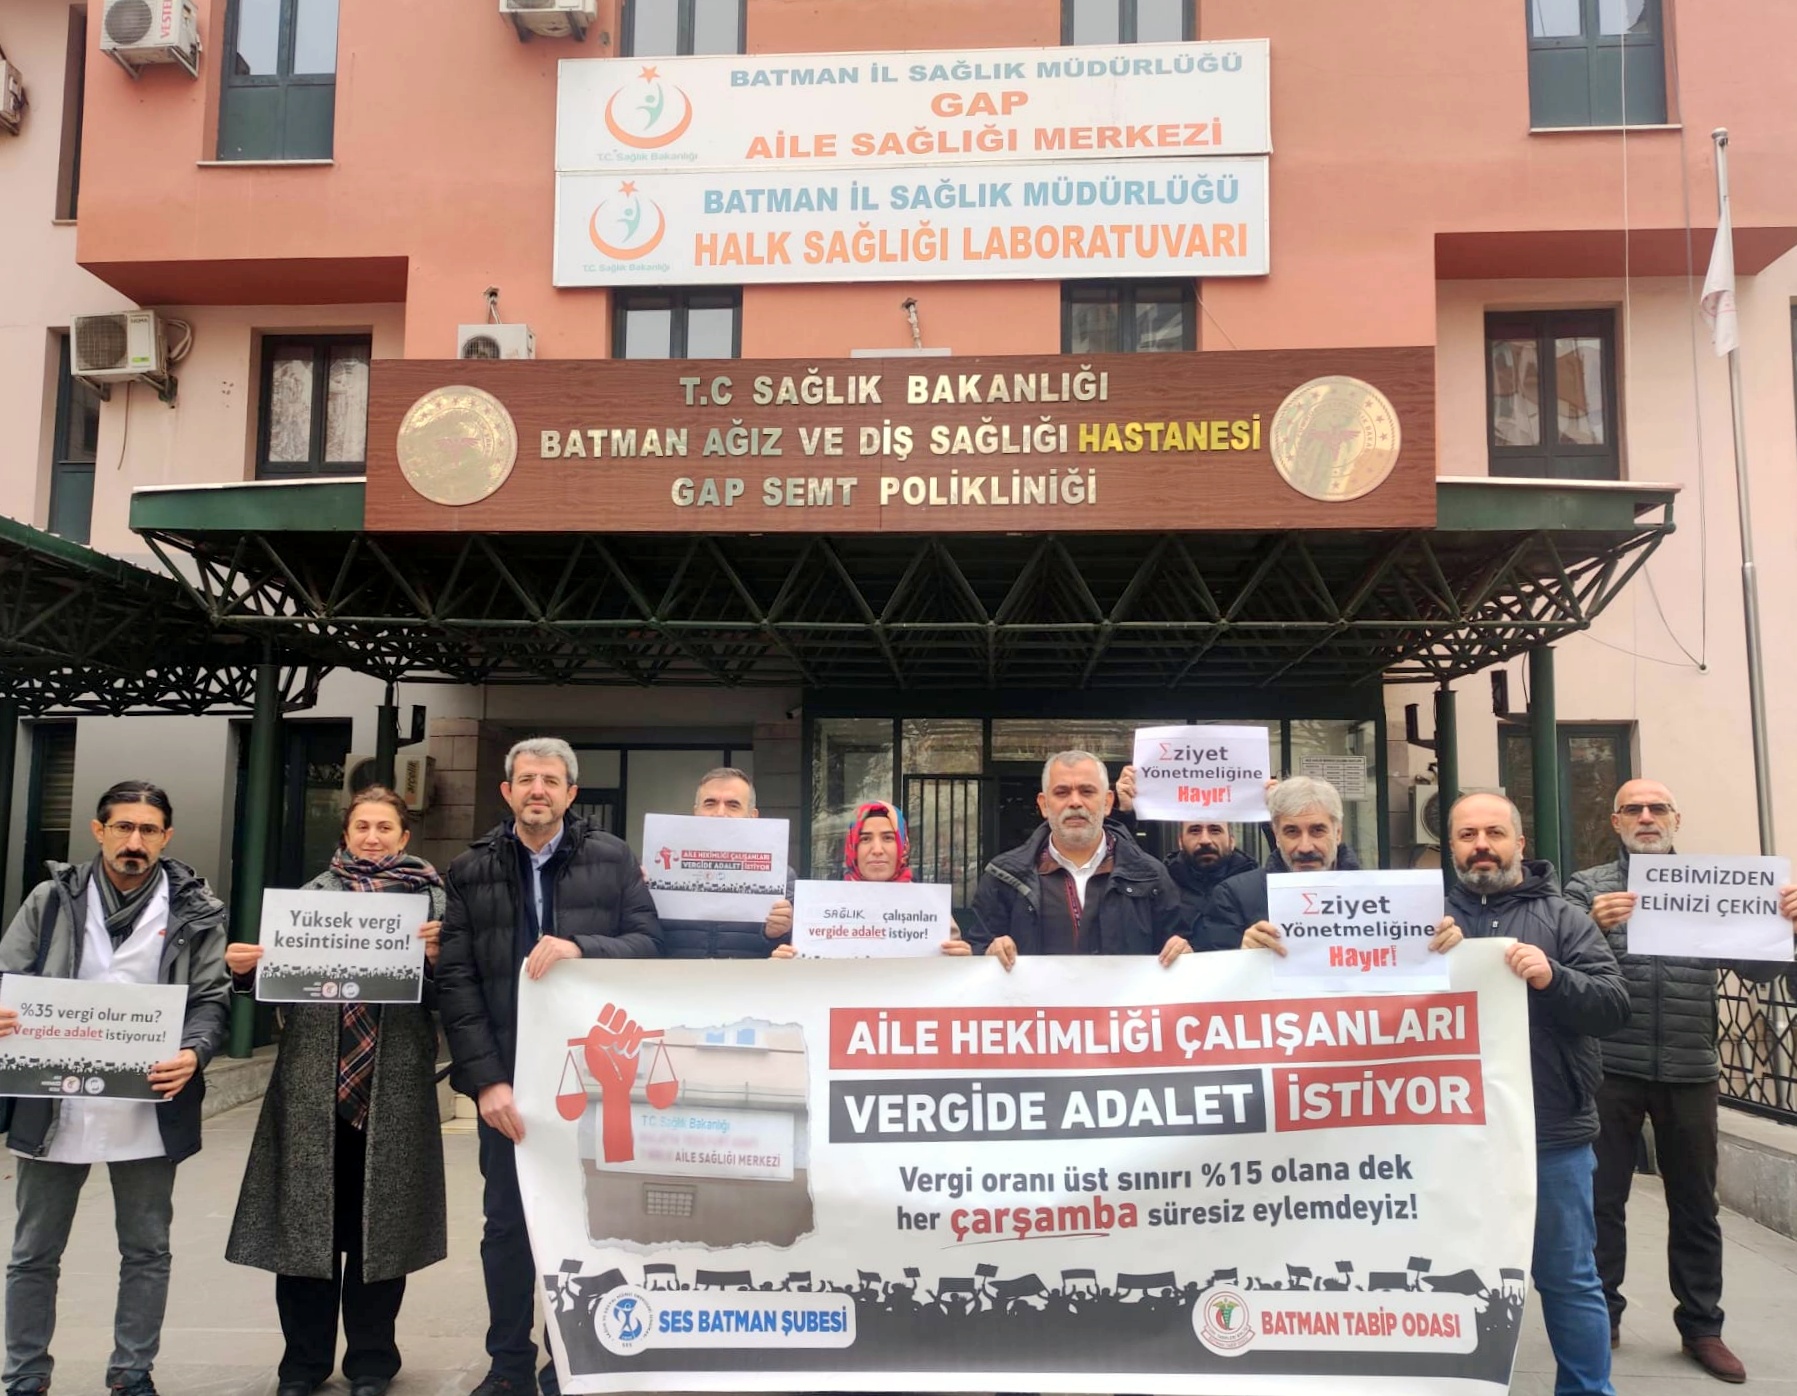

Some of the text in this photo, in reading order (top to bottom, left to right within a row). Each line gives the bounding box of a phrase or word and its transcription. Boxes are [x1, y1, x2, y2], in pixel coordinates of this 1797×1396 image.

[731, 52, 1242, 87] BATMAN İL SAĞLIK MÜDÜRLÜĞÜ
[930, 91, 1028, 117] GAP
[745, 117, 1222, 159] AİLE SAĞLIĞI MERKEZİ
[616, 152, 648, 162] Sağlık
[651, 151, 698, 162] Bakanlığı
[704, 173, 1239, 214] BATMAN İL SAĞLIK MÜDÜRLÜĞÜ
[694, 219, 1247, 266] HALK SAĞLIĞI LABORATUVARI
[679, 364, 1108, 405] T.C SAĞLIK BAKANLIĞI
[540, 428, 688, 458] BATMAN
[702, 418, 783, 456] AĞIZ
[798, 426, 844, 455] VE
[859, 419, 914, 461] DİŞ
[930, 415, 1068, 455] SAĞLIĞI
[1078, 413, 1261, 452] HASTANESİ
[671, 467, 1097, 507] GAP SEMT POLİKLİNİĞİ
[1141, 766, 1263, 782] Yönetmeliğine
[1178, 785, 1231, 806] Hayır!
[683, 860, 770, 870] VERGİDE ADALET İSTİYOR
[1646, 865, 1774, 886] CEBİMİZDEN
[823, 907, 937, 924] SAĞLIK çalışanları
[1641, 893, 1777, 917] ELİNİZİ ÇEKİN
[290, 909, 402, 934] Yüksek vergi
[809, 925, 928, 941] vergide adalet istiyor!
[1281, 921, 1435, 940] Yönetmeliğine
[274, 930, 410, 951] kesintisine son!
[1329, 945, 1397, 972] Hayır!
[21, 1002, 162, 1023] %35 vergi olur mu?
[13, 1024, 166, 1043] Vergide adalet istiyoruz!
[846, 1005, 1466, 1059] AİLE HEKİMLİĞİ ÇALIŞANLARI
[844, 1070, 1473, 1133] VERGİDE ADALET İSTİYOR
[675, 1148, 696, 1163] AİLE
[698, 1150, 736, 1165] SAĞLIĞI
[738, 1153, 781, 1168] MERKEZİ
[899, 1153, 1414, 1199] Vergi oranı üst sınırı %15 olana dek
[897, 1193, 1418, 1241] her çarşamba süresiz eylemdeyiz!
[659, 1310, 693, 1332] SES
[699, 1310, 777, 1332] BATMAN
[781, 1306, 847, 1336] ŞUBESİ
[1261, 1311, 1339, 1335] BATMAN
[1343, 1306, 1397, 1336] TABİP
[1402, 1312, 1461, 1338] ODASI
